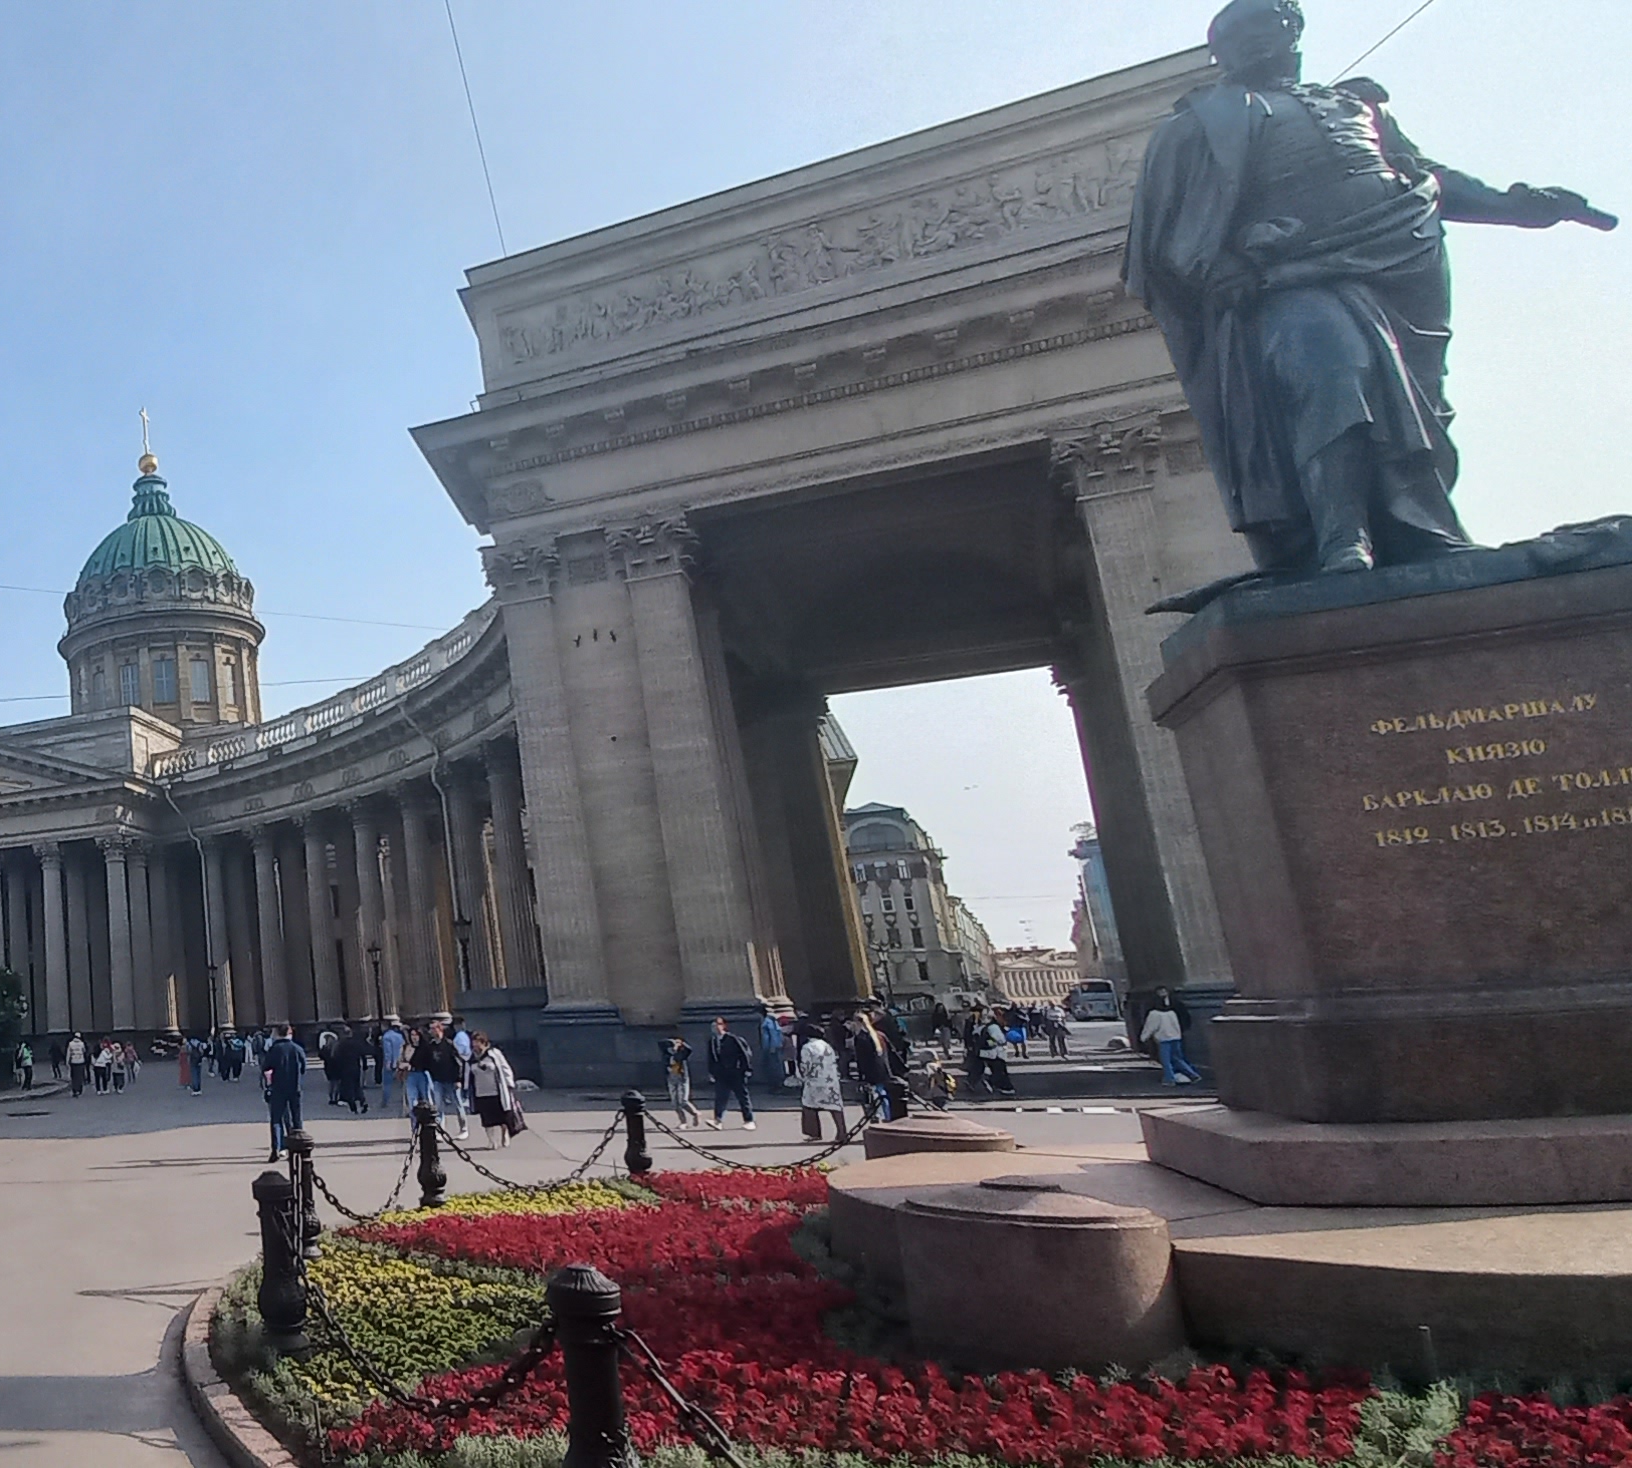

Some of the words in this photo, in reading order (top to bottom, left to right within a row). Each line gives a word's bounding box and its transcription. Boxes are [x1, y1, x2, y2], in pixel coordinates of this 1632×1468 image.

[1371, 694, 1597, 735] ФЕЛЬДМАРШАЛУ
[1445, 738, 1545, 765] КНЯЗЮ
[1362, 783, 1493, 812] БАРКЛАЮ
[1507, 776, 1543, 799] ДЕ
